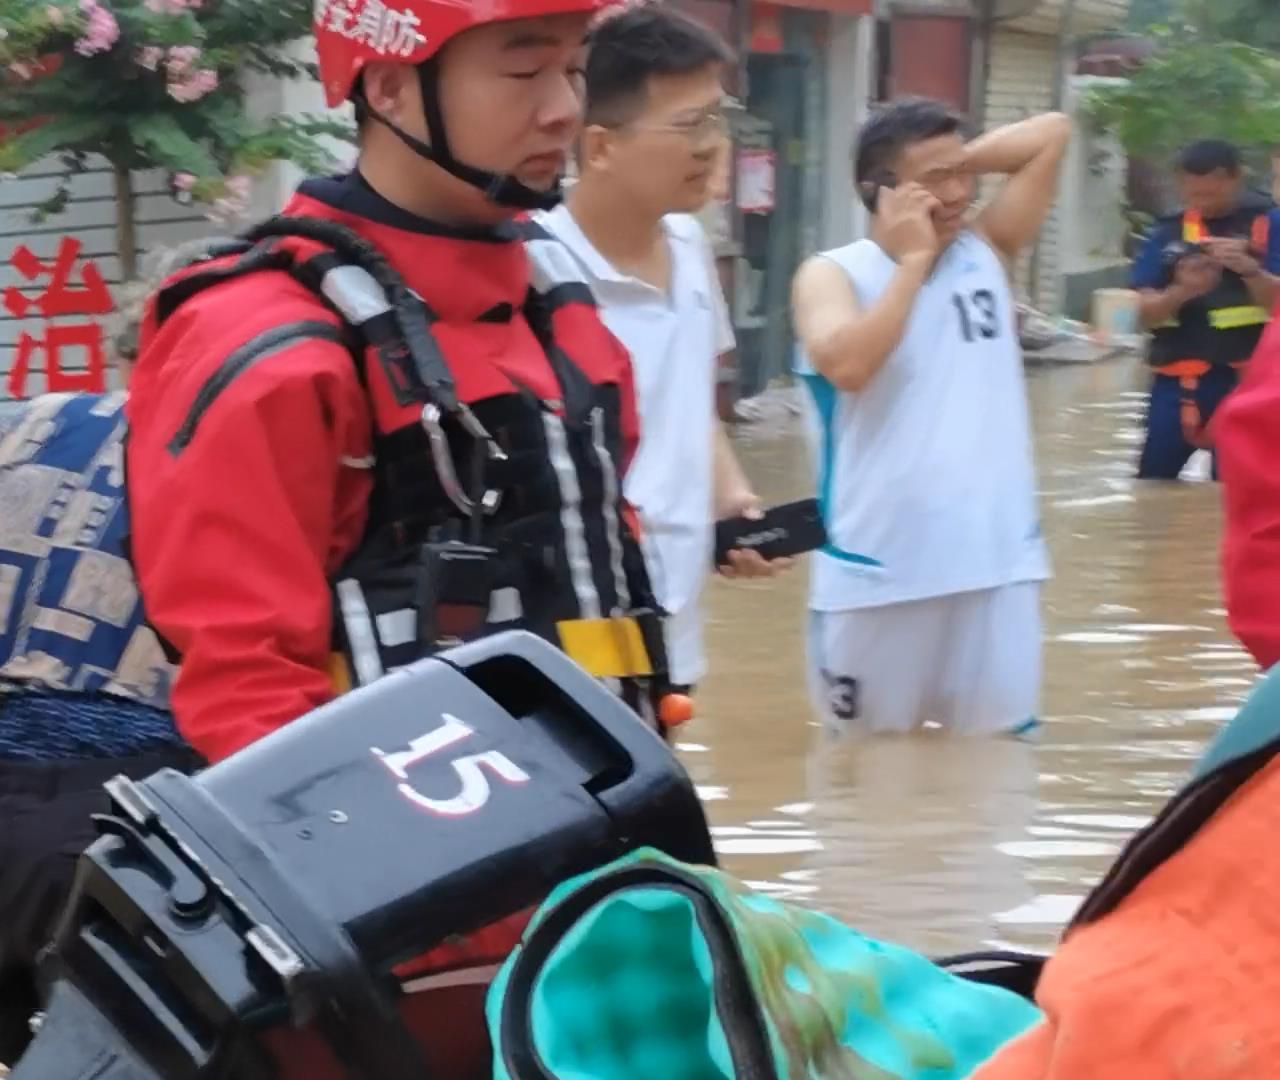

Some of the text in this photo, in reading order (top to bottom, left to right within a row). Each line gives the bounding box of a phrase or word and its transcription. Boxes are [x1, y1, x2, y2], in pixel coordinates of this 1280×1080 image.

[314, 0, 427, 57] 消防
[951, 287, 1002, 343] 13
[370, 712, 531, 818] 15
